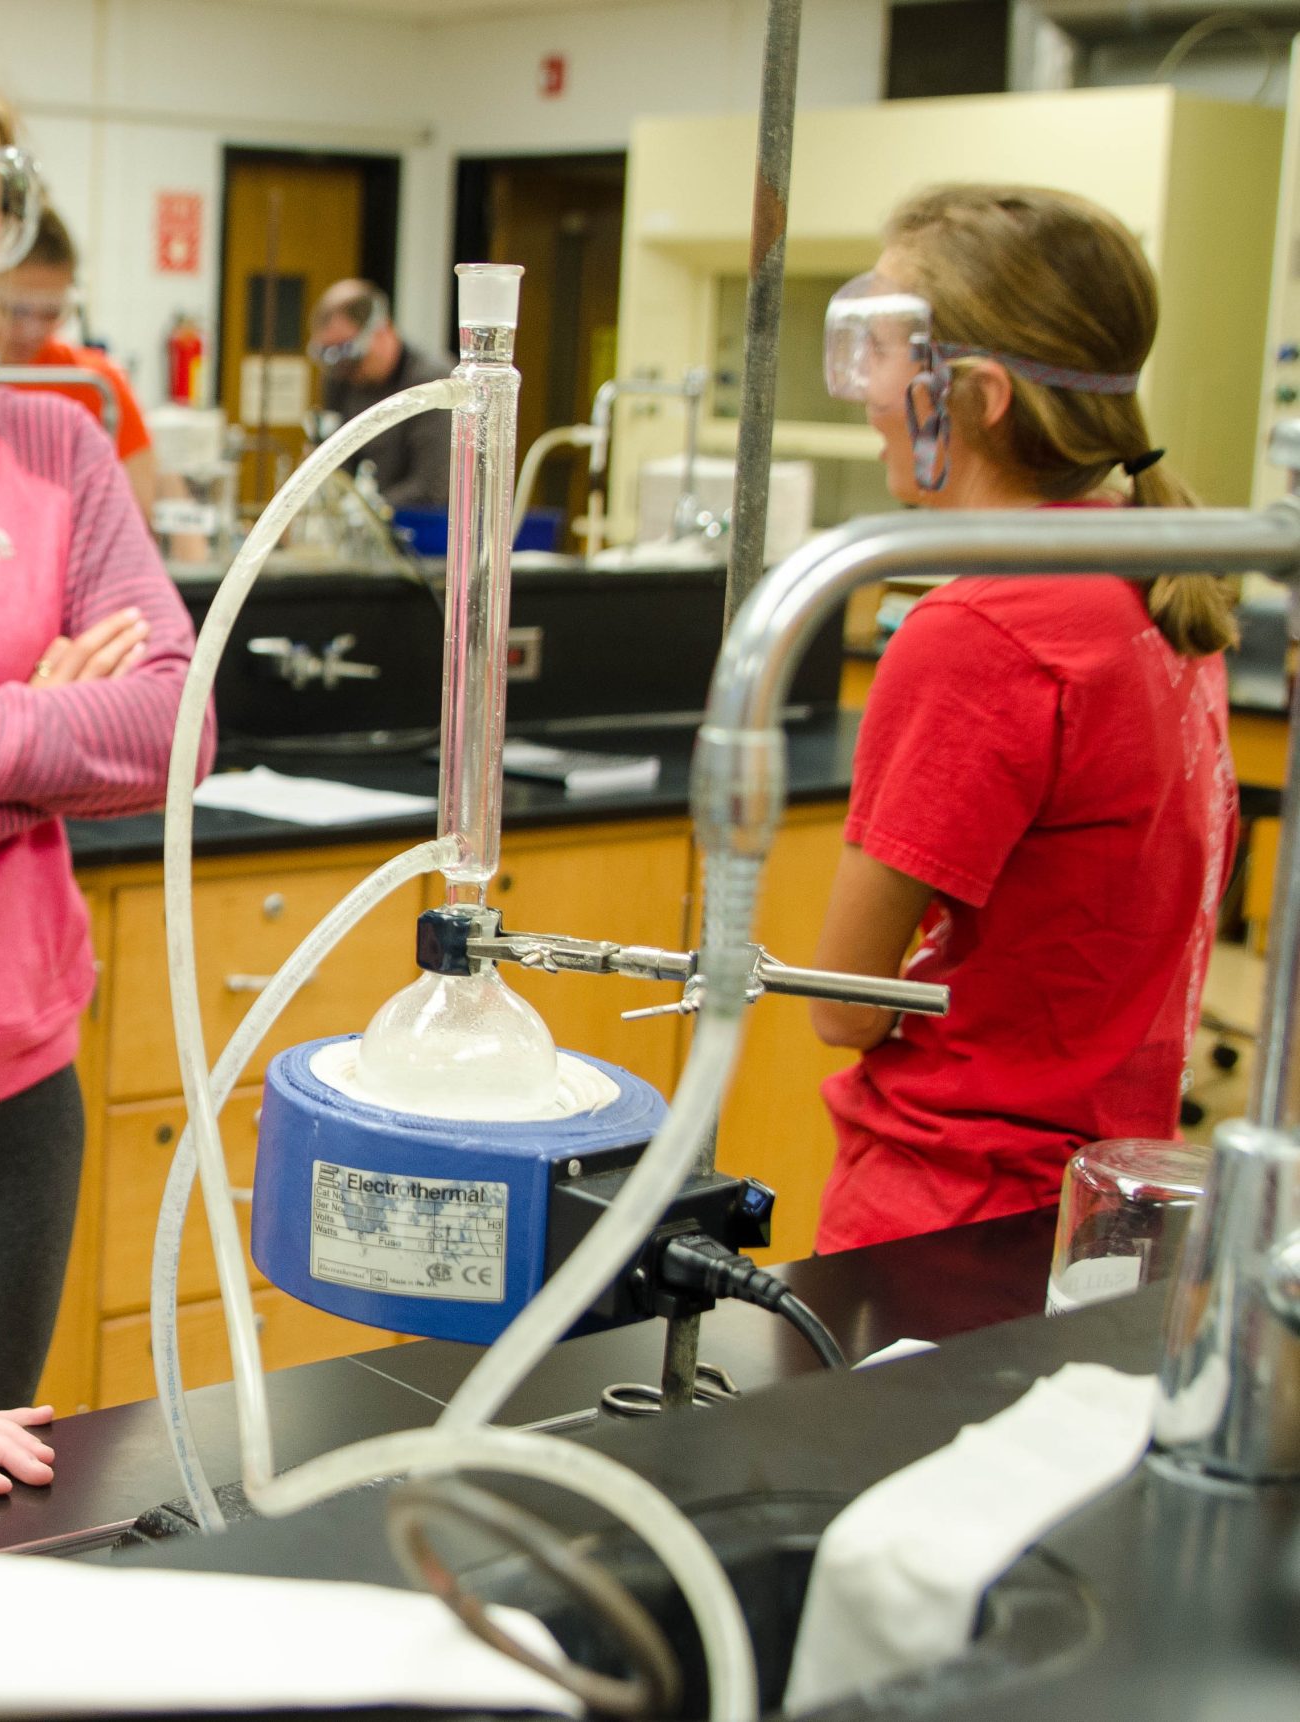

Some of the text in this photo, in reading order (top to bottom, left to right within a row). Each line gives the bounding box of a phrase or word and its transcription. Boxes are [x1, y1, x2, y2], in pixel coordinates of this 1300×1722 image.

[348, 1172, 485, 1203] Electrthermal
[315, 1198, 329, 1209] Ser
[315, 1211, 335, 1224] Volts
[315, 1223, 338, 1237] Watts
